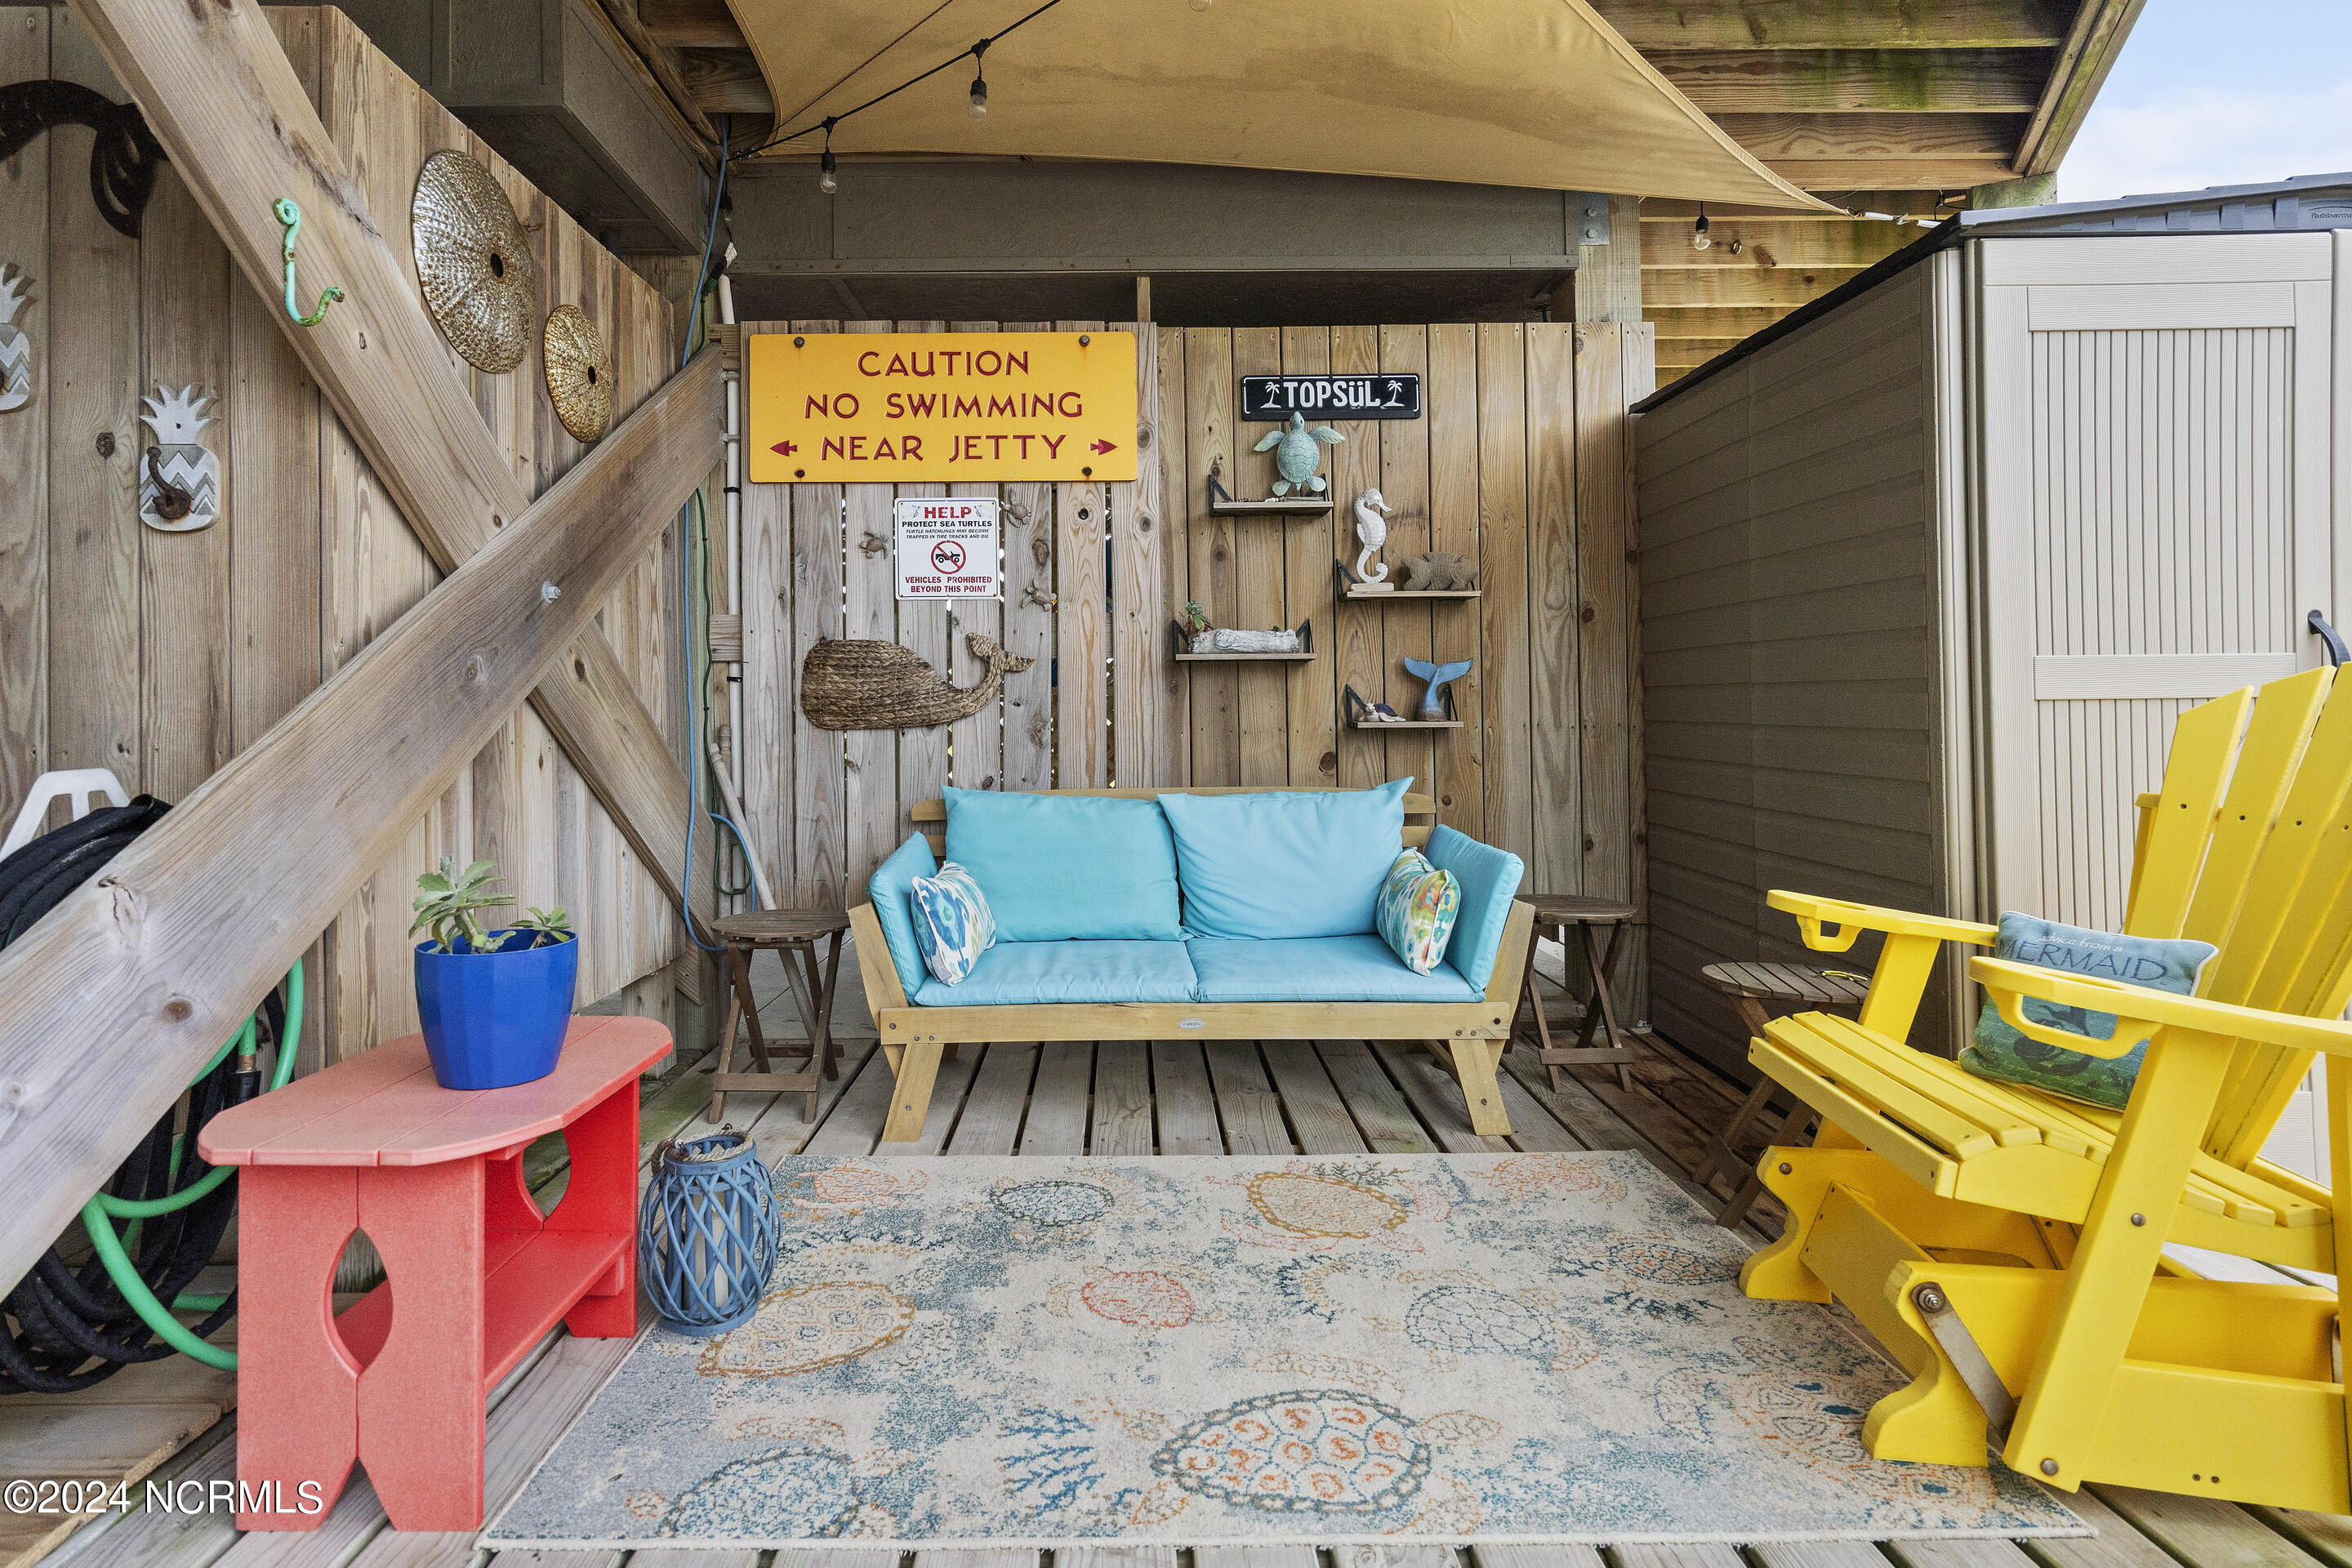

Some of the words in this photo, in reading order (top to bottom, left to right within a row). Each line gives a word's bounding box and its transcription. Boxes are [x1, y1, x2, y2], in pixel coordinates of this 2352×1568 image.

[858, 350, 1029, 377] CAUTION
[804, 393, 860, 420] NO
[885, 391, 1083, 419] SWIMMING
[821, 434, 924, 461] NEAR
[948, 434, 1067, 464] JETTY
[924, 506, 972, 519] HELP
[905, 576, 942, 584] VEHICLES
[947, 576, 992, 584] PROHIBITED
[2079, 937, 2109, 951] from
[1998, 938, 2167, 981] MERMAID
